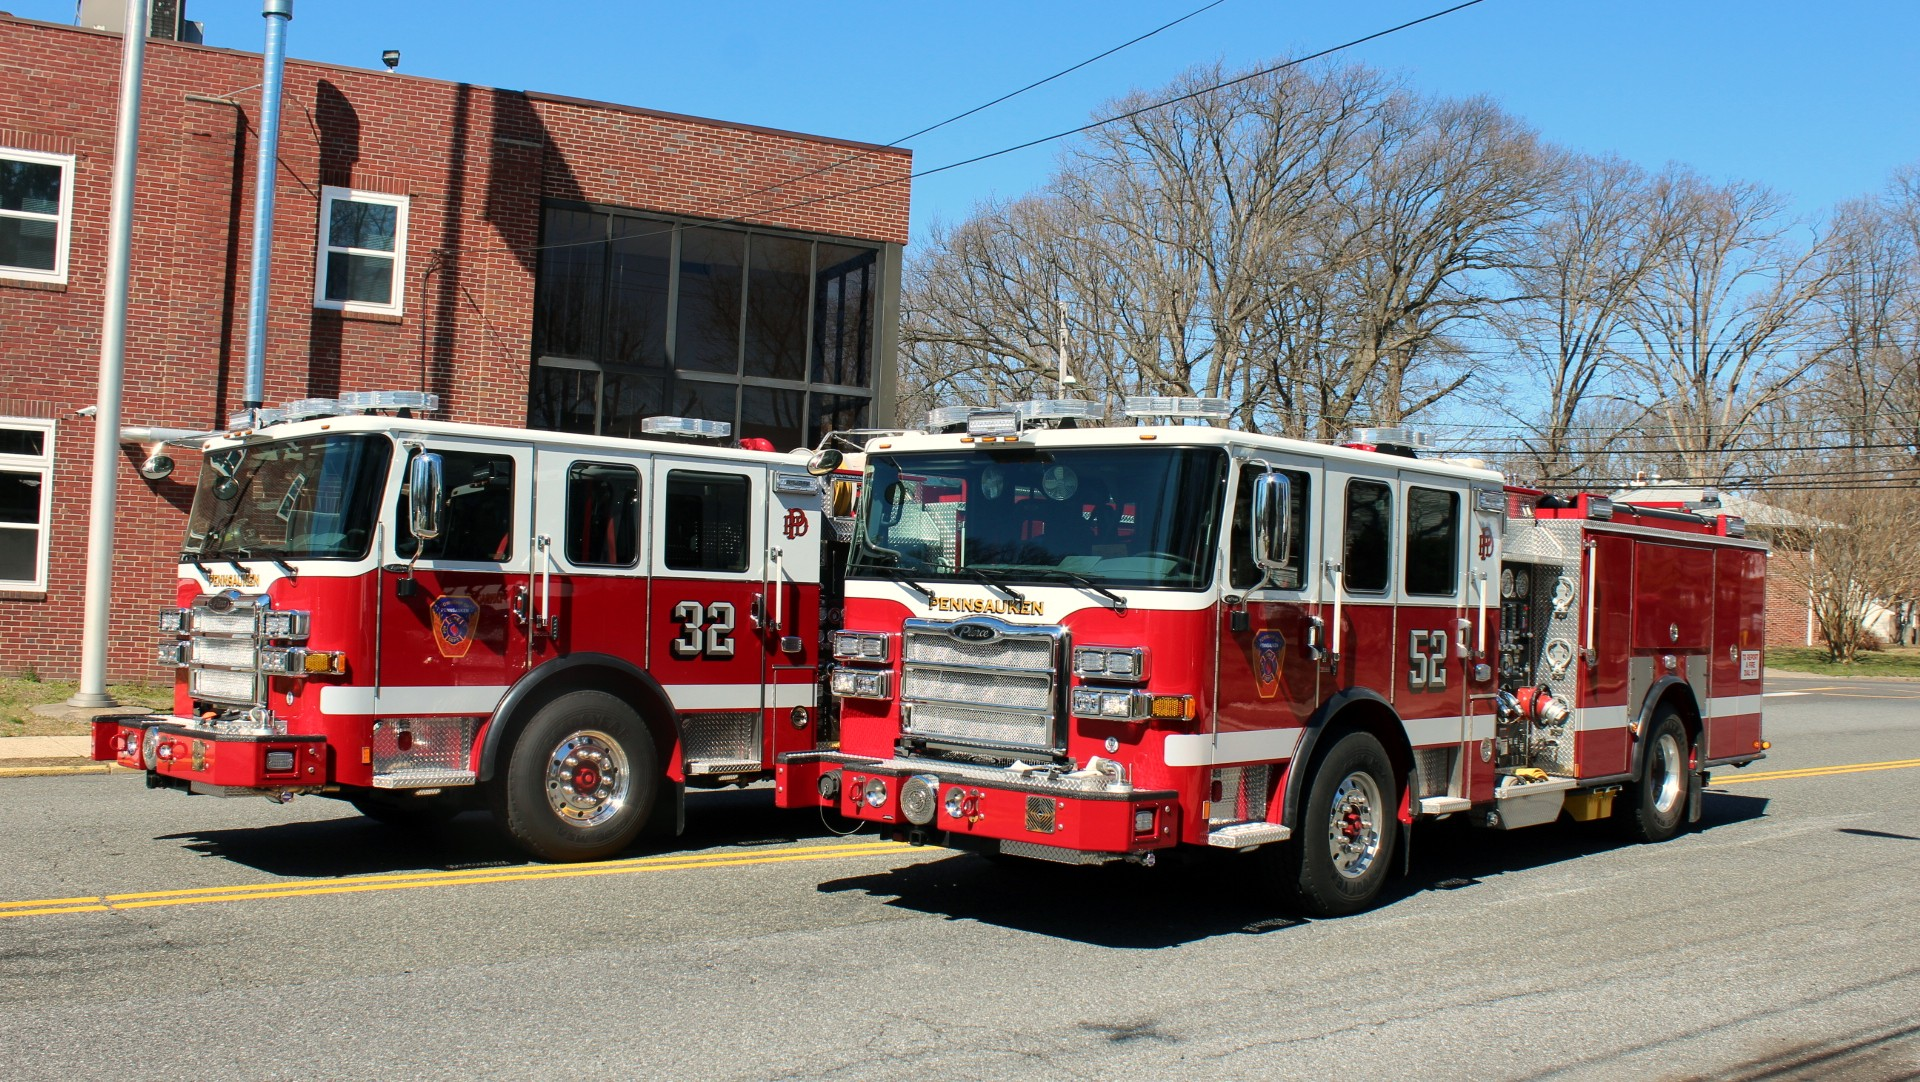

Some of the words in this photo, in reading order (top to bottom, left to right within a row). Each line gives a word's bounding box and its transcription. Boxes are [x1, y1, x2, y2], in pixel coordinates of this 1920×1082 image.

[208, 574, 260, 587] PENNSAUKEN
[928, 597, 1045, 616] PENNSAUKEN
[673, 600, 736, 656] 32
[959, 625, 989, 638] Pierce
[1409, 629, 1448, 689] 52
